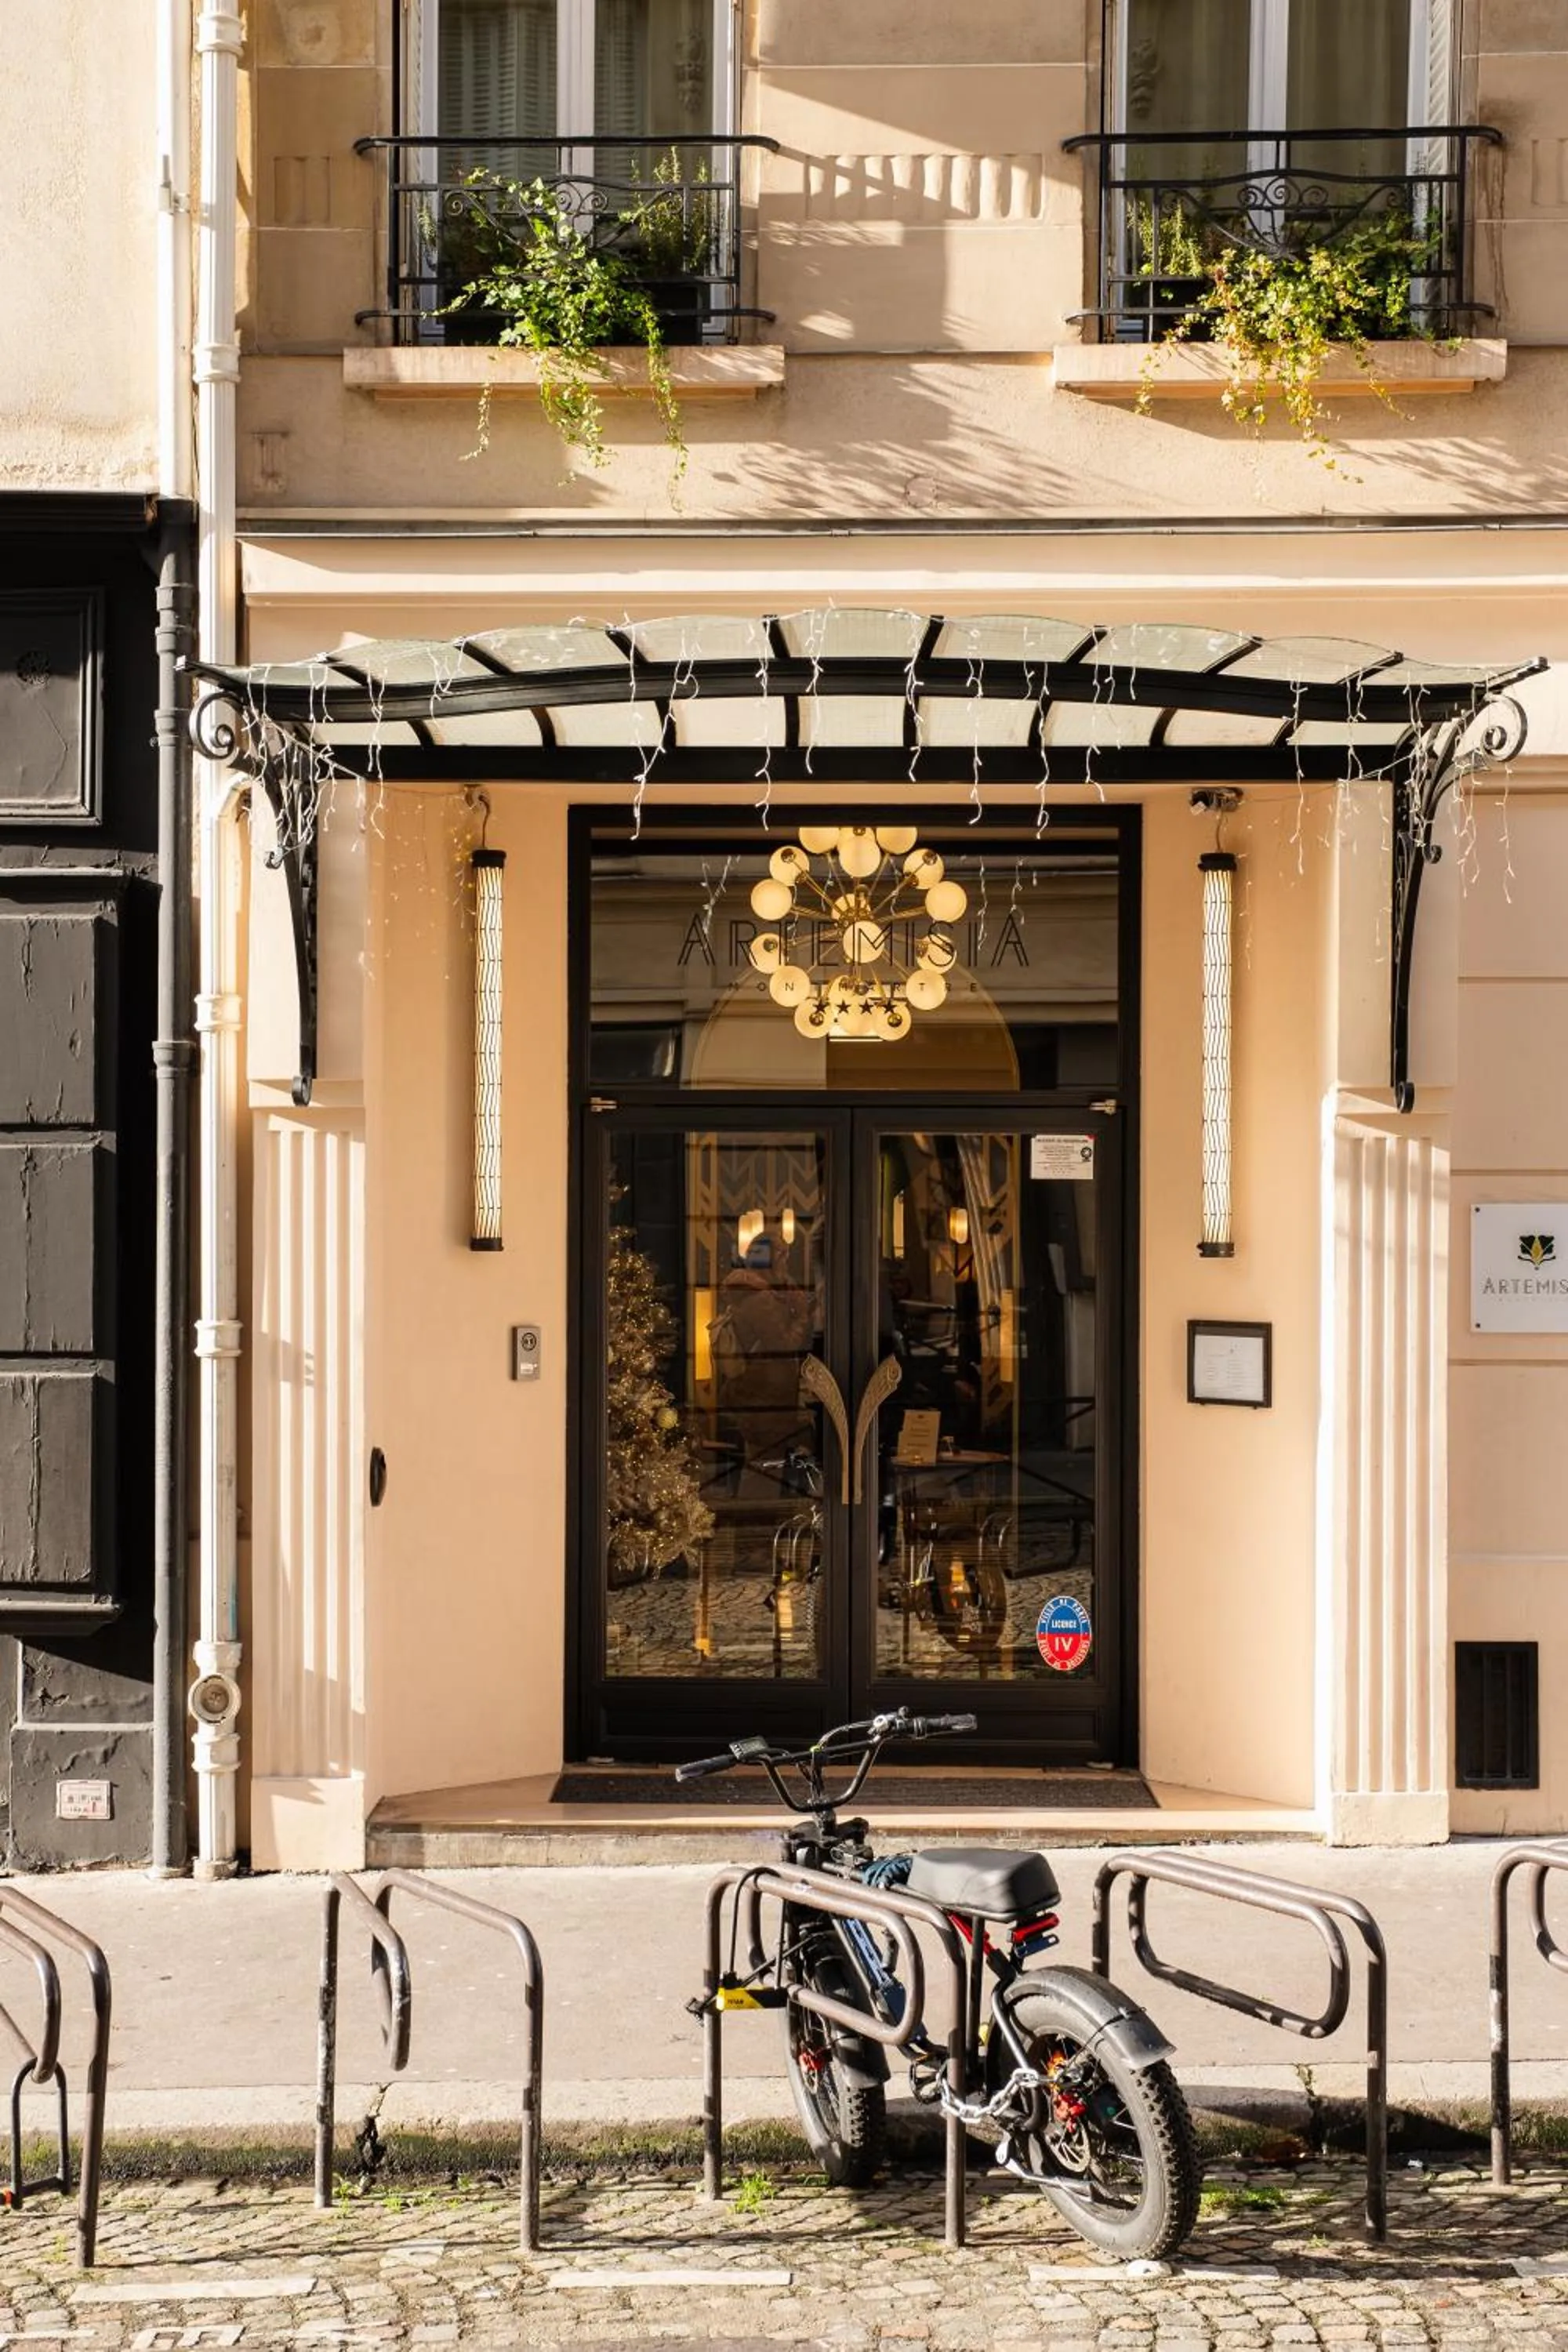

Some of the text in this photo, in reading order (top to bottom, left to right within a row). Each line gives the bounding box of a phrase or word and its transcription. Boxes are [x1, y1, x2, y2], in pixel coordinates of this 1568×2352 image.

[677, 913, 1029, 967] ARTEMISIA
[1483, 1277, 1568, 1294] ARTEMIS
[1051, 1619, 1077, 1628] LICENCE
[1054, 1636, 1073, 1652] IV
